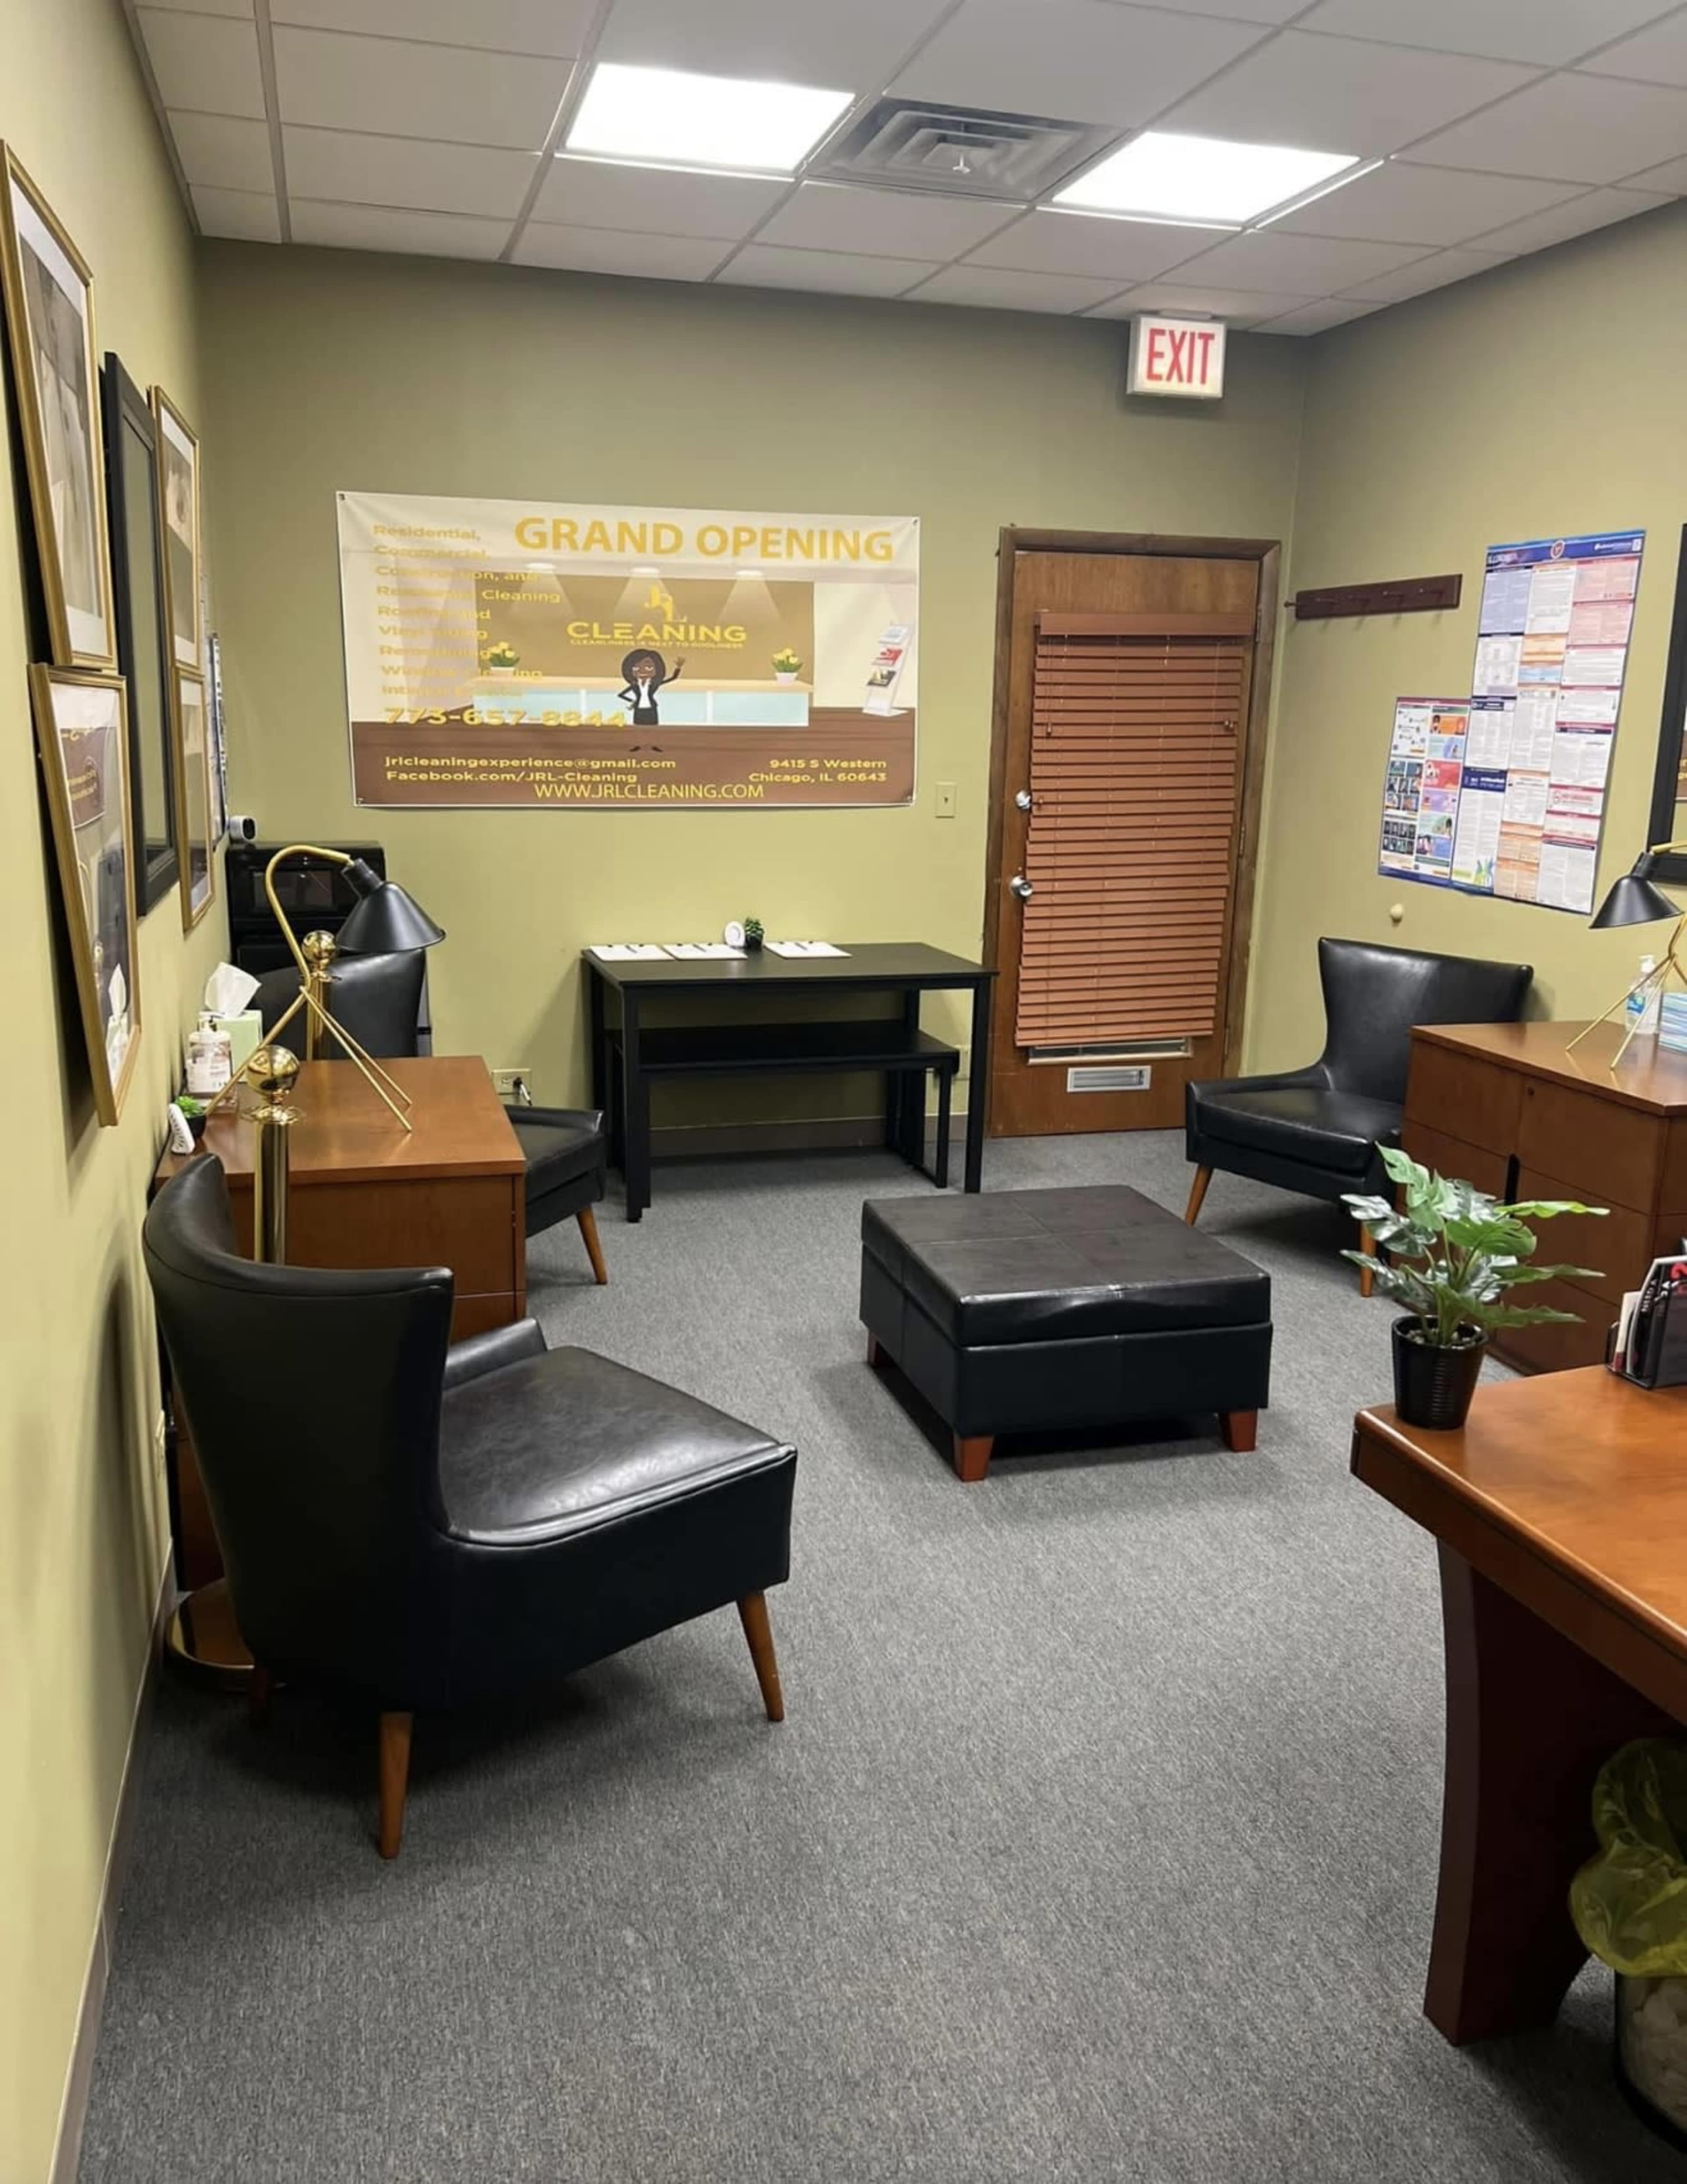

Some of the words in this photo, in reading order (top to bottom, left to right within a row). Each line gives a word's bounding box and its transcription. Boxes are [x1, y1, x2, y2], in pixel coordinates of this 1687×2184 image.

[1146, 328, 1215, 385] EXIT
[374, 525, 481, 541] Residential,
[514, 517, 683, 555] GRAND
[696, 525, 893, 561] OPENING
[482, 590, 560, 603] Cleaning
[566, 621, 746, 642] CLEANING
[385, 707, 626, 727] 773-657-8844
[385, 756, 676, 769] jrlcleaningexperience@gmail.com
[770, 759, 806, 768] 9415
[809, 759, 819, 768] S
[823, 759, 887, 769] Western
[386, 771, 637, 783] Facebook.com/JRL-Cleaning
[748, 772, 815, 784] Chicago,
[819, 773, 833, 782] IL
[837, 773, 887, 783] 60643
[533, 784, 764, 799] WWW.JRLCLEANING.COM
